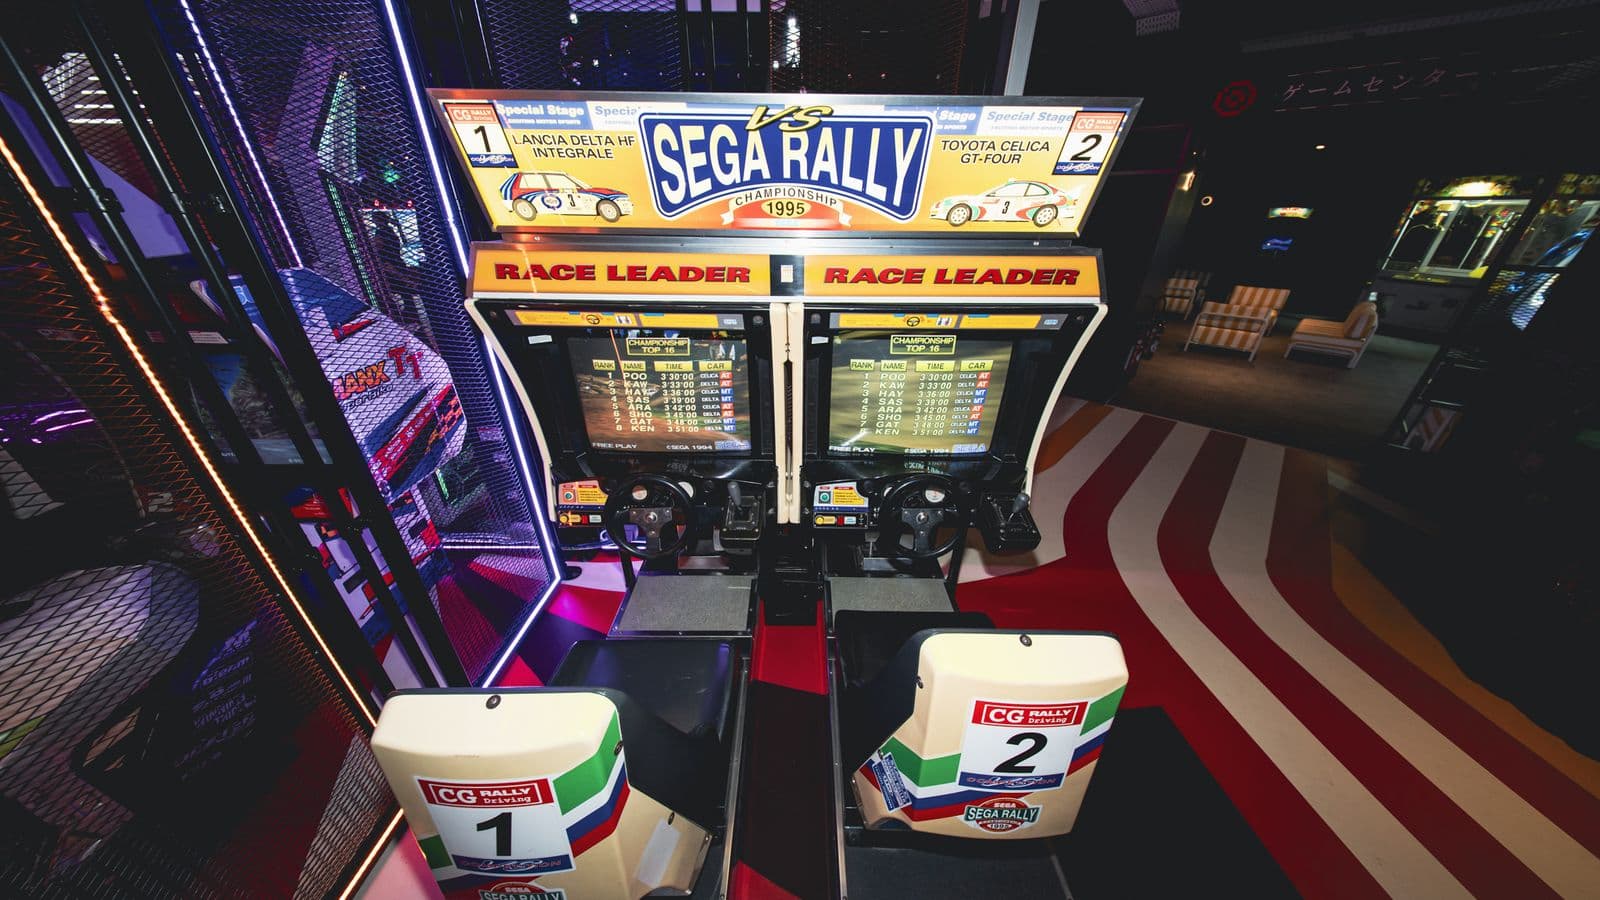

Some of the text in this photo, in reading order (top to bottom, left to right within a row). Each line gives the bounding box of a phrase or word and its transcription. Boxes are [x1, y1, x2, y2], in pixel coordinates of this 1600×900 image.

[452, 110, 472, 120] CG
[496, 104, 584, 118] Special Stage
[940, 110, 977, 122] Stage
[987, 111, 1074, 124] Special Stage
[745, 105, 834, 132] VS
[1076, 118, 1095, 130] CG
[474, 125, 492, 152] 1
[512, 134, 636, 147] LANCIA DELTA HF
[941, 140, 1050, 152] TOYOTA CELICA
[1070, 134, 1102, 161] 2
[532, 147, 614, 160] INTEGRALE
[960, 153, 1022, 164] GT-FOUR
[653, 123, 923, 207] SEGA RALLY
[568, 194, 576, 207] 3
[735, 187, 837, 206] CHAMPIONSHIP
[767, 201, 805, 216] 1995
[1002, 200, 1010, 214] 3
[494, 263, 752, 283] RACE LEADER
[824, 268, 1080, 286] RACE LEADER
[989, 708, 1072, 724] CG RALLY
[1028, 716, 1068, 724] Driving
[992, 732, 1048, 774] 2
[438, 788, 531, 804] CG RALLY
[484, 796, 532, 805] Driving
[968, 808, 1037, 821] SEGA RALLY
[476, 812, 513, 856] 1
